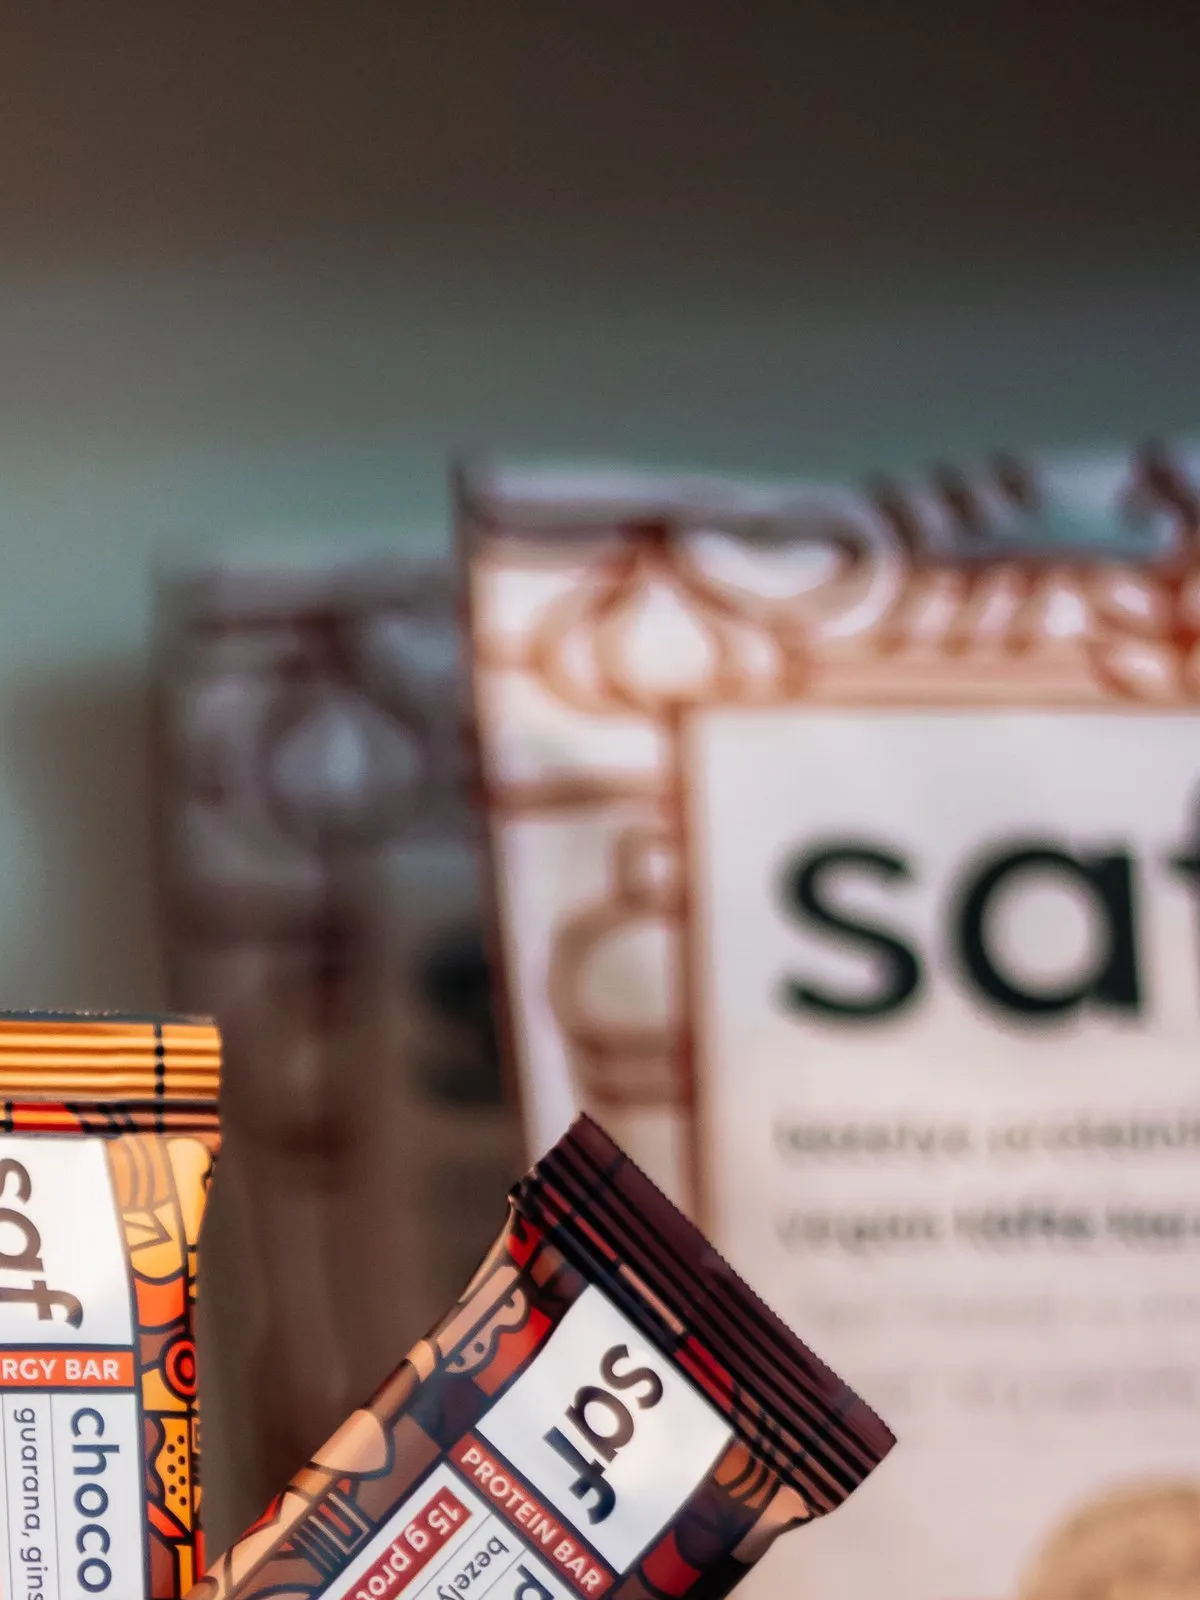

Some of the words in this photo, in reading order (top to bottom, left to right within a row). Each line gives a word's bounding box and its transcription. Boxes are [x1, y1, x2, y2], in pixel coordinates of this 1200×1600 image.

[65, 1358, 120, 1381] BAR
[14, 1408, 41, 1538] guarana,
[542, 1344, 664, 1525] saf
[403, 1526, 430, 1552] g
[427, 1495, 461, 1534] 15
[460, 1446, 559, 1545] PROTEIN
[552, 1540, 602, 1592] BAR
